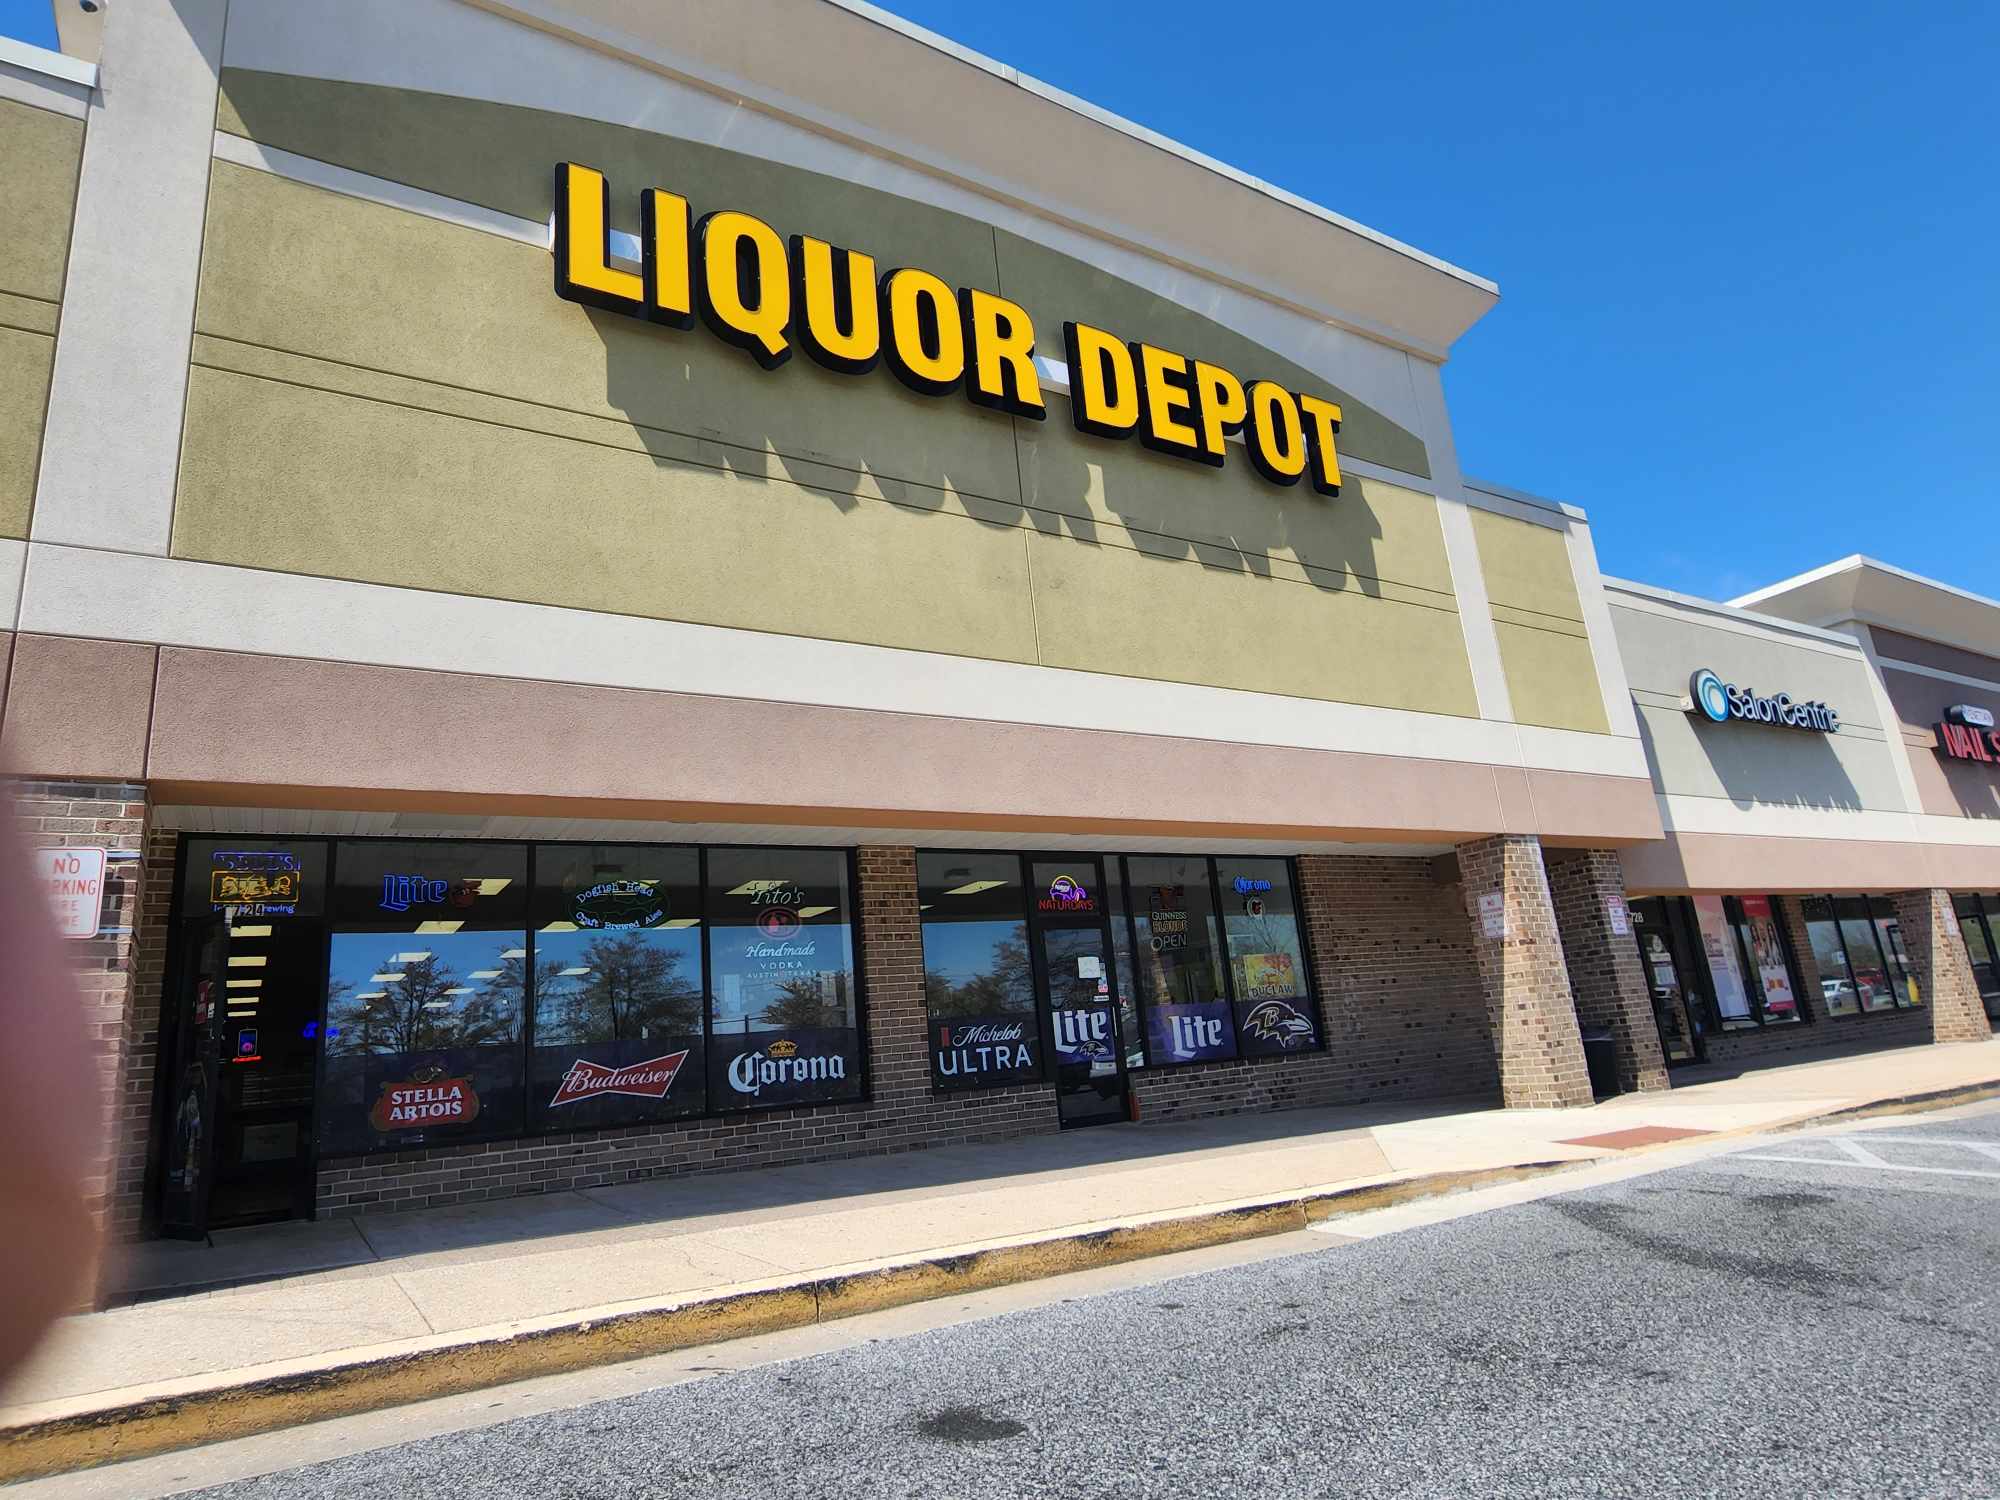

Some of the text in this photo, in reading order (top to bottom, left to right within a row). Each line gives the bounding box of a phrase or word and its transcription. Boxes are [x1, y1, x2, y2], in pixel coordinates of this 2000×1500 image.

[555, 162, 1342, 497] LIQUOR DEPOT
[1724, 683, 1841, 733] SalonCentric
[1940, 721, 1993, 761] NAIL
[53, 858, 80, 874] NO
[380, 874, 448, 912] Lite
[576, 881, 654, 903] Dogfish Head
[750, 878, 804, 905] Tito's
[1234, 877, 1271, 894] Corona
[604, 919, 640, 930] Brewed
[645, 909, 663, 924] Ales
[1151, 911, 1187, 921] GUINNESS
[745, 940, 816, 958] Handmade
[1151, 935, 1187, 951] OPEN
[760, 961, 803, 970] VODKA
[952, 1022, 1023, 1047] Michelob
[1052, 1009, 1107, 1054] Lite
[1168, 1015, 1223, 1059] Lite
[938, 1044, 1033, 1076] ULTRA
[562, 1067, 675, 1093] Budweiser
[728, 1051, 846, 1097] Corona
[391, 1086, 463, 1105] STELLA
[389, 1101, 463, 1121] ARTOIS
